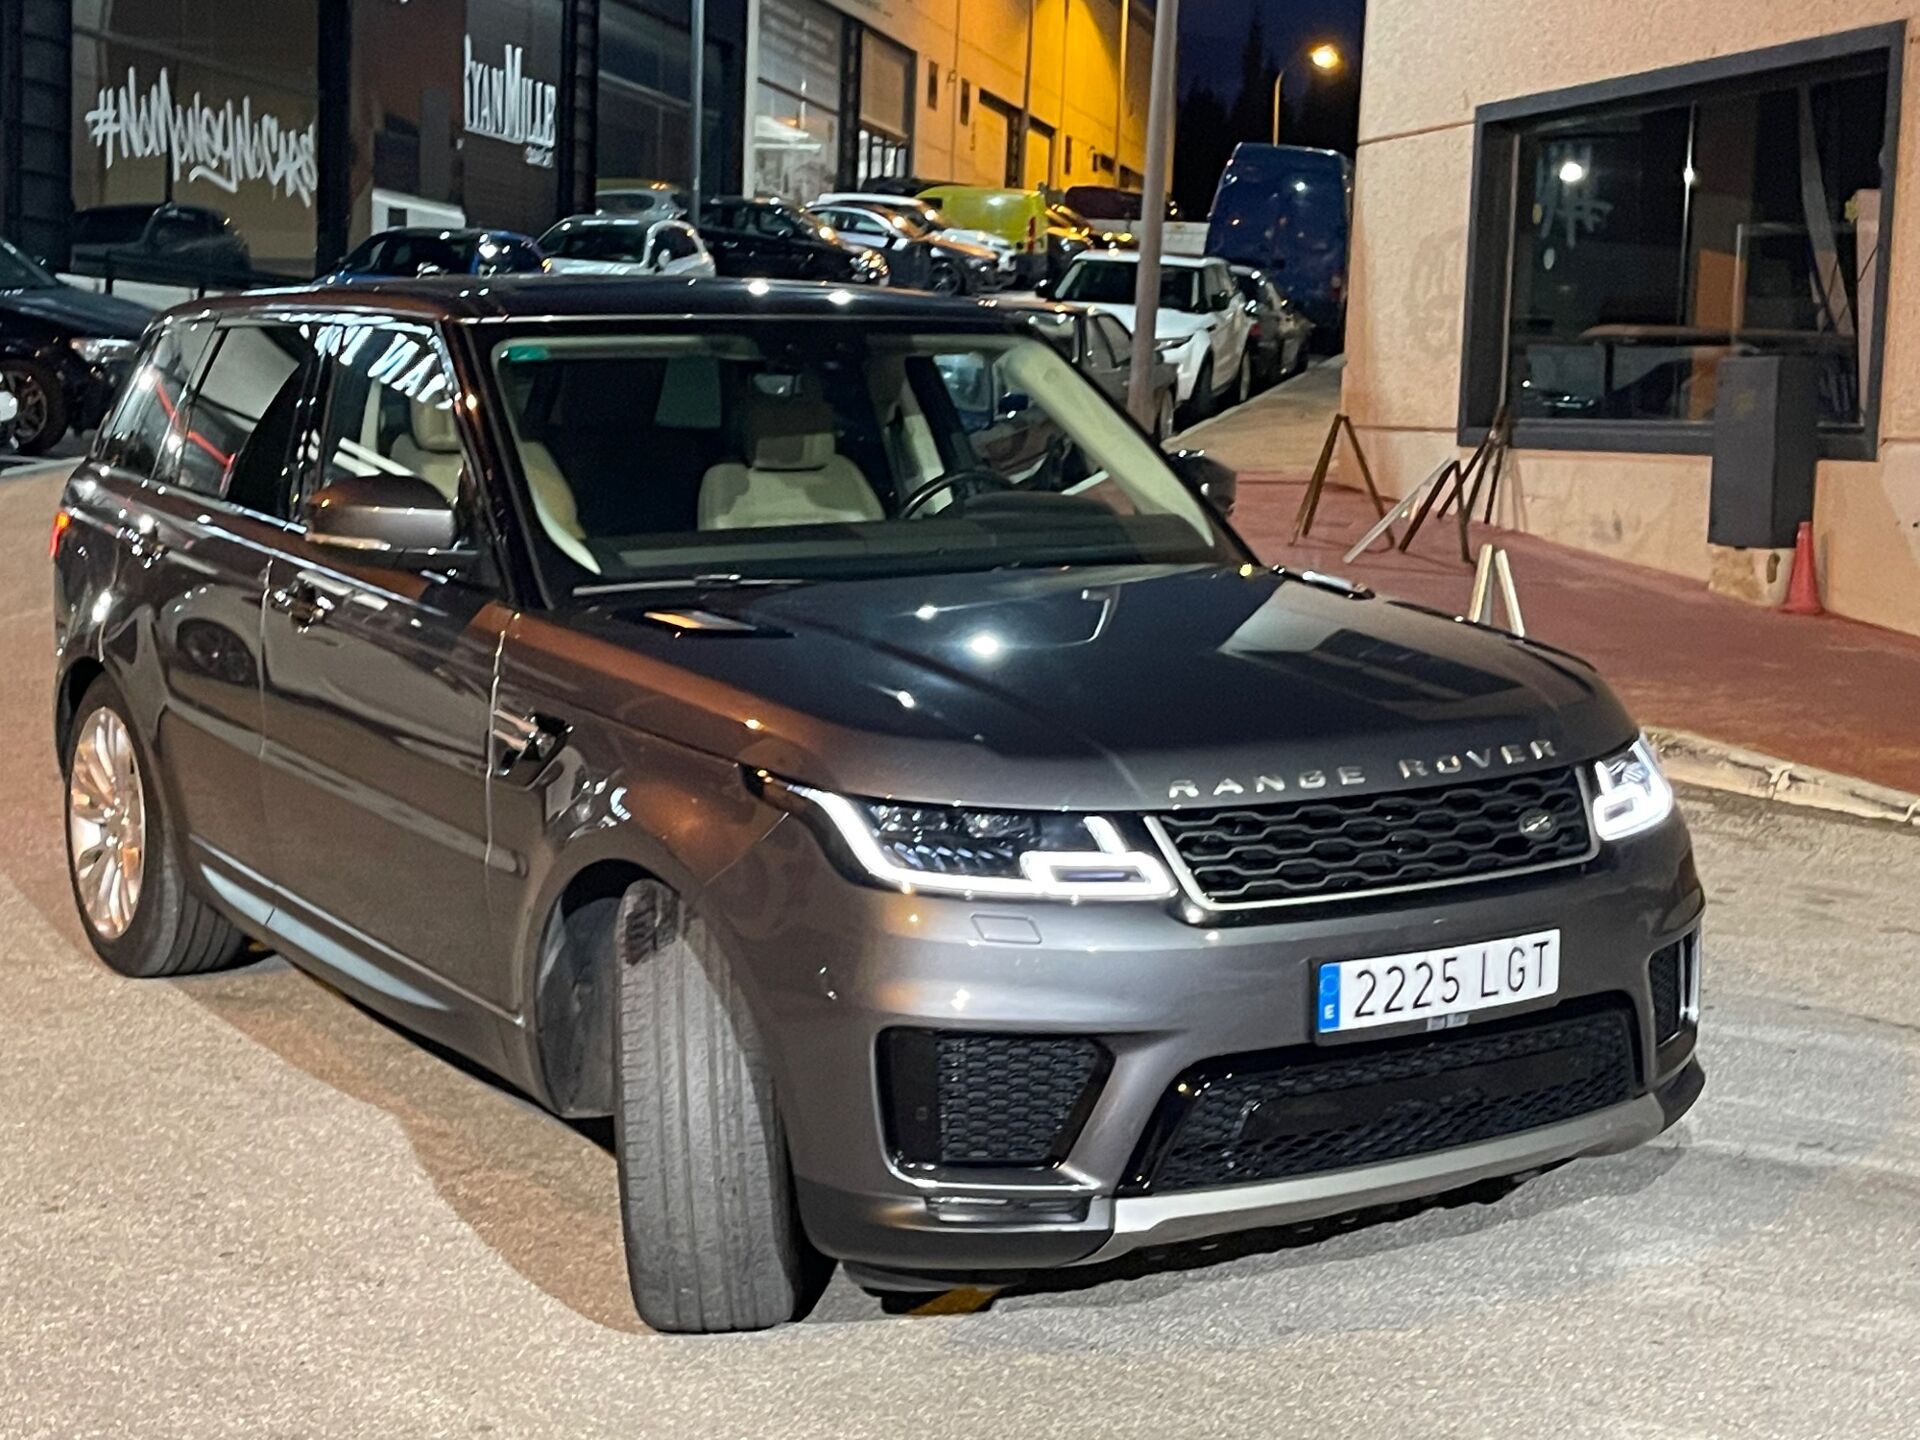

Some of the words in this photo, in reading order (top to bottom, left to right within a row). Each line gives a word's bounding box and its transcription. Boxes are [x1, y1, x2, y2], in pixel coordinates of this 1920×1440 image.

[1168, 766, 1366, 799] RANGE
[1398, 740, 1556, 780] ROVER
[1354, 956, 1461, 1018] 2225
[1480, 941, 1551, 998] LGT
[1324, 1003, 1336, 1020] E
